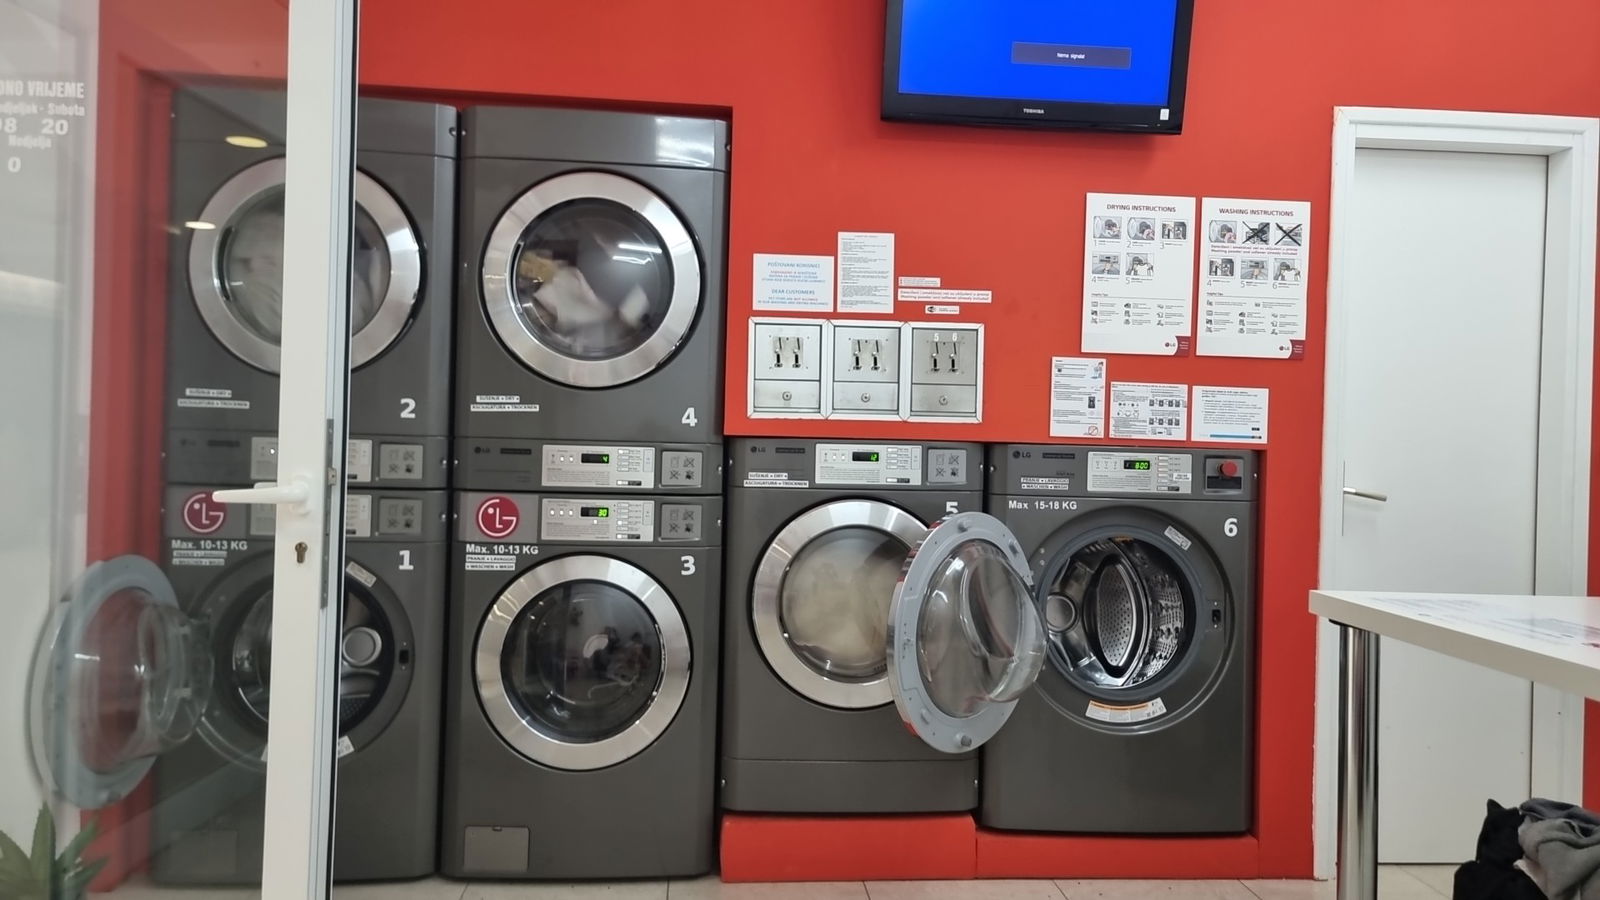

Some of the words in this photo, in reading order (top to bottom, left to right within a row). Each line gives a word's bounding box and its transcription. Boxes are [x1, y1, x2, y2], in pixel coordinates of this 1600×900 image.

[28, 80, 84, 98] VRIJEME
[0, 117, 17, 134] 8
[41, 118, 69, 136] 20
[1131, 204, 1176, 213] INSTRUCTIONS
[1218, 208, 1248, 216] WASHING
[1250, 208, 1294, 217] INSTRUCTIONS
[1160, 242, 1164, 250] 3
[934, 332, 939, 342] 5
[952, 332, 957, 341] 6
[400, 398, 416, 418] 2
[682, 407, 698, 426] 4
[183, 492, 226, 534] LG
[1008, 500, 1028, 509] Max
[1034, 501, 1060, 510] 15-18
[1062, 501, 1077, 510] KG
[478, 498, 518, 538] LG
[1224, 518, 1238, 537] 6
[171, 540, 196, 549] Max.
[200, 540, 228, 549] 10-13
[230, 541, 248, 550] KG
[466, 544, 490, 553] Max.
[493, 545, 520, 554] 10-13
[522, 545, 539, 555] KG
[398, 550, 414, 570] 1
[681, 555, 696, 575] 3
